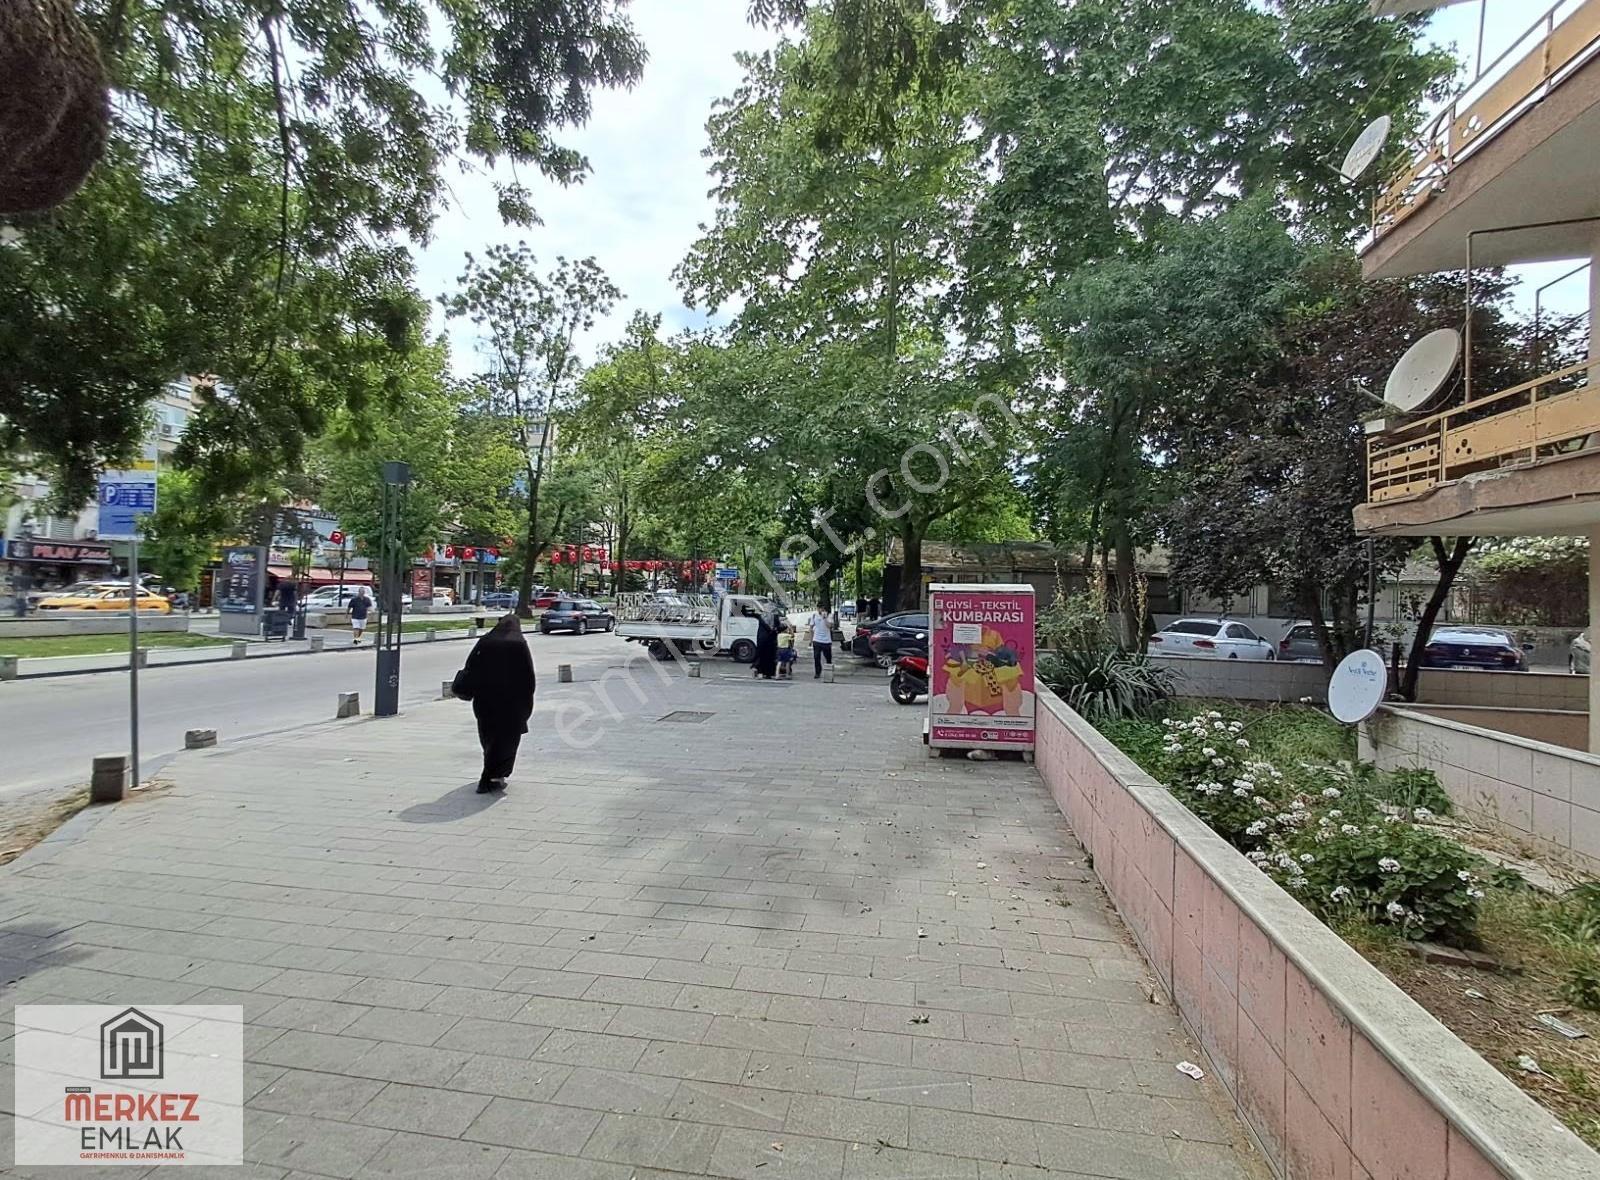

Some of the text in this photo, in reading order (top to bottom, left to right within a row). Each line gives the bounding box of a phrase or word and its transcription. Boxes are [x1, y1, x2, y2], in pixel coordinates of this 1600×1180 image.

[105, 486, 116, 502] P
[946, 599, 972, 610] GİYSİ
[980, 600, 1022, 611] TEKSTİL
[943, 611, 1024, 623] KUMBARASI
